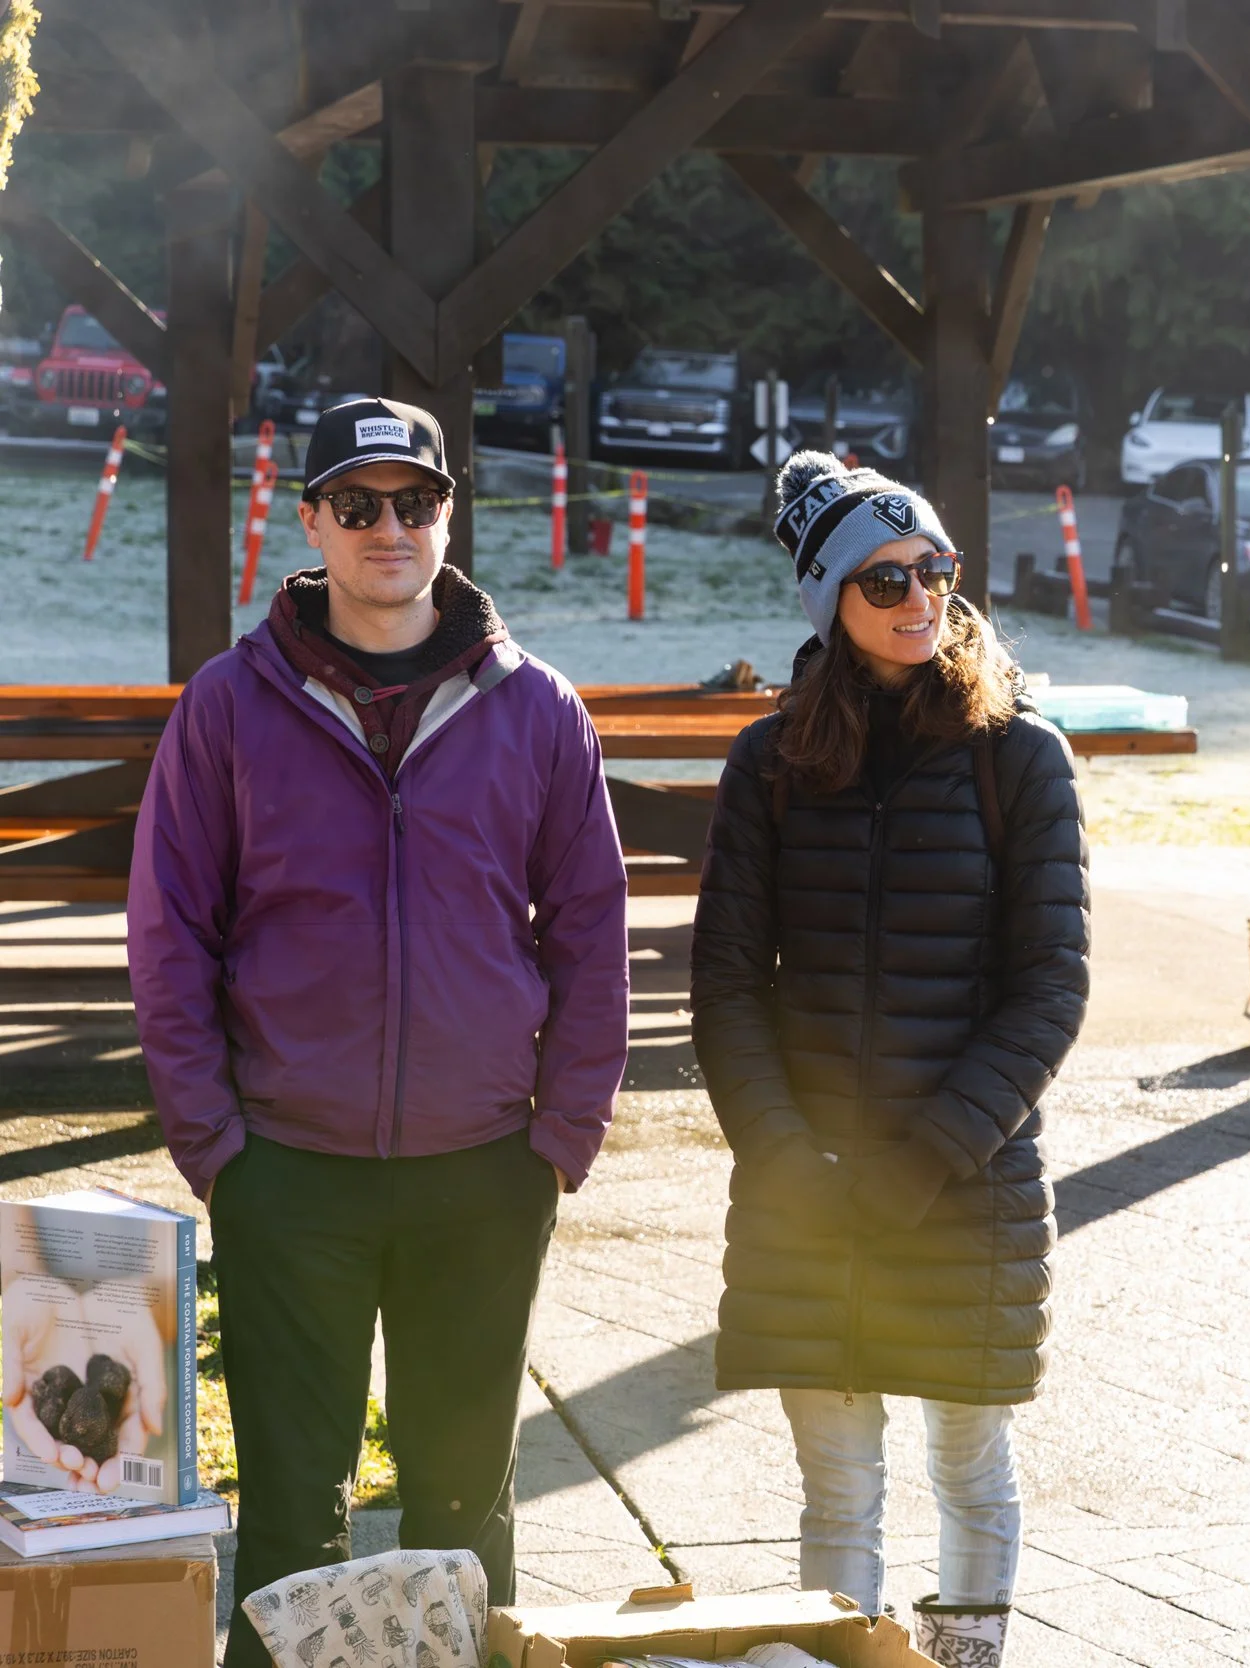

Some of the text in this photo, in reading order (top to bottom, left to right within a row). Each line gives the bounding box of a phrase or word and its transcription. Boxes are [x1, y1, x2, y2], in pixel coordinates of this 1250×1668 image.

[360, 425, 404, 433] WHISTLER
[18, 1652, 26, 1665] X
[47, 1651, 54, 1663] X
[99, 1648, 137, 1660] CARTON
